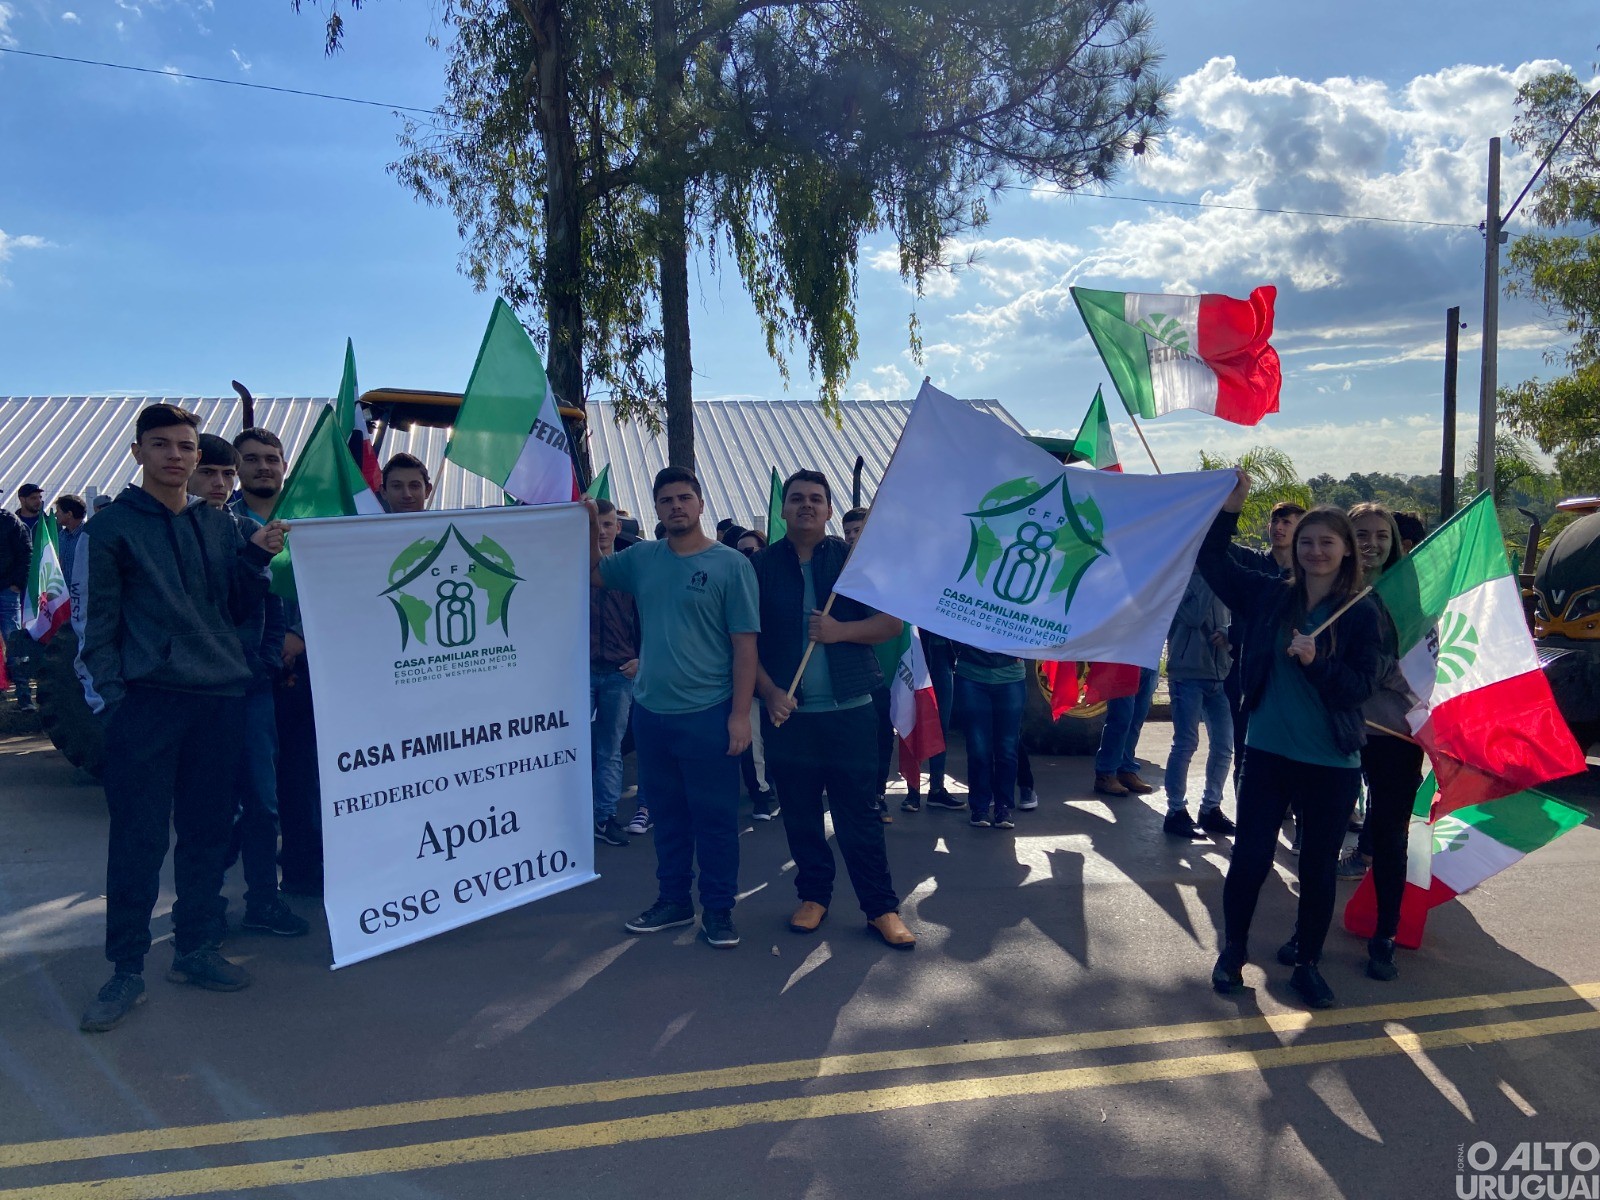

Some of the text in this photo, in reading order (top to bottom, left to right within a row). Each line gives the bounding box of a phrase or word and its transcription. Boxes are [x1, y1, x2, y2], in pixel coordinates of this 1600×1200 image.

[70, 583, 80, 622] WEST
[935, 606, 1041, 646] FREDERICO WESTPHALEN
[938, 597, 976, 617] ESCOLA
[978, 612, 993, 622] DE
[995, 617, 1032, 635] ENSINO
[1034, 629, 1066, 645] MÉDIO
[943, 587, 1070, 635] CASA FAMILIAR RURAL
[394, 644, 516, 669] CASA FAMILIAR RURAL
[394, 653, 517, 679] ESCOLA DE ENSINO MÉDIO
[395, 674, 442, 686] FREDERICO
[445, 665, 498, 678] WESTPHALEN
[337, 710, 570, 773] CASA FAMILHAR RURAL
[333, 748, 578, 817] FREDERICO WESTPHALEN
[416, 806, 521, 861] Apoia
[359, 849, 576, 935] esse evento.
